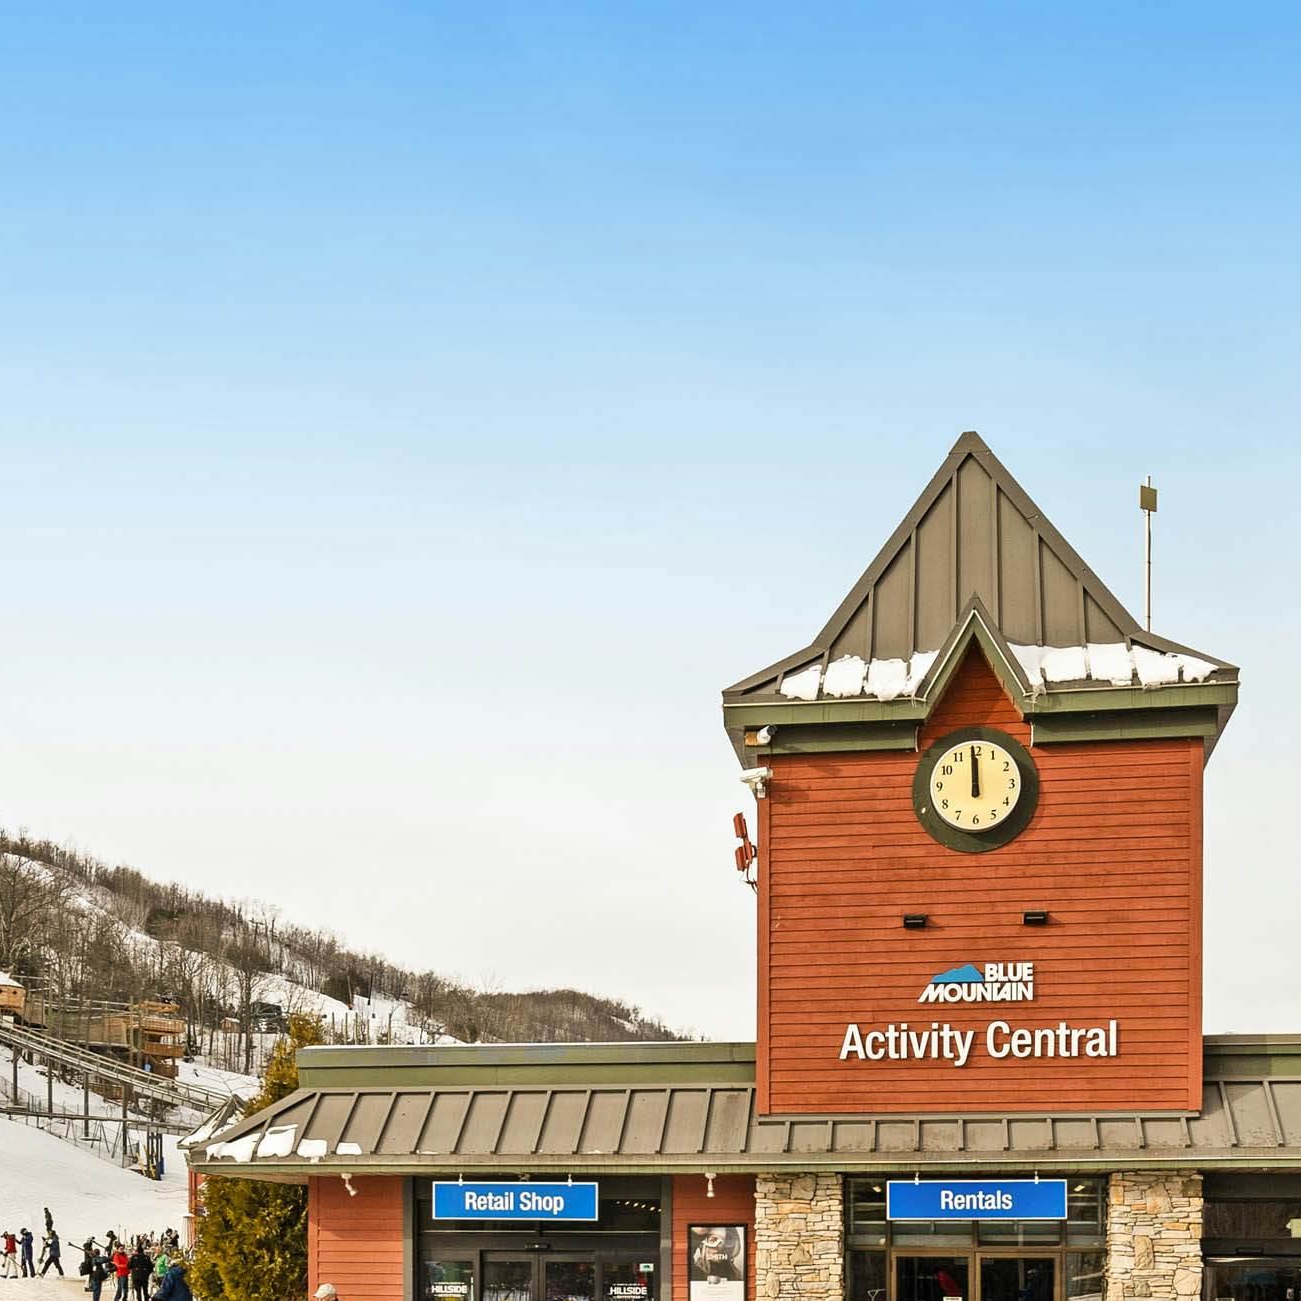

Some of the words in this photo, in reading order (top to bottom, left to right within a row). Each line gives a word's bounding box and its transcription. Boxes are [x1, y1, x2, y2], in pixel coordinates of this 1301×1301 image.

[954, 752, 964, 762] 11
[990, 750, 996, 760] 1
[941, 765, 953, 775] 10
[1003, 761, 1010, 772] 2
[936, 782, 943, 792] 9
[1008, 778, 1016, 789] 3
[942, 799, 949, 809] 8
[1002, 796, 1010, 807] 4
[955, 810, 962, 821] 7
[973, 814, 980, 825] 6
[990, 809, 997, 820] 5
[984, 962, 1034, 982] BLUE
[917, 981, 1034, 1003] MOUNTAIN
[839, 1022, 975, 1067] Activity
[985, 1020, 1118, 1058] Central
[464, 1191, 514, 1211] Retail
[519, 1191, 565, 1215] Shop
[940, 1190, 1013, 1210] Rentals
[431, 1284, 468, 1294] HILLSIDE
[609, 1286, 648, 1295] HILLSIDE
